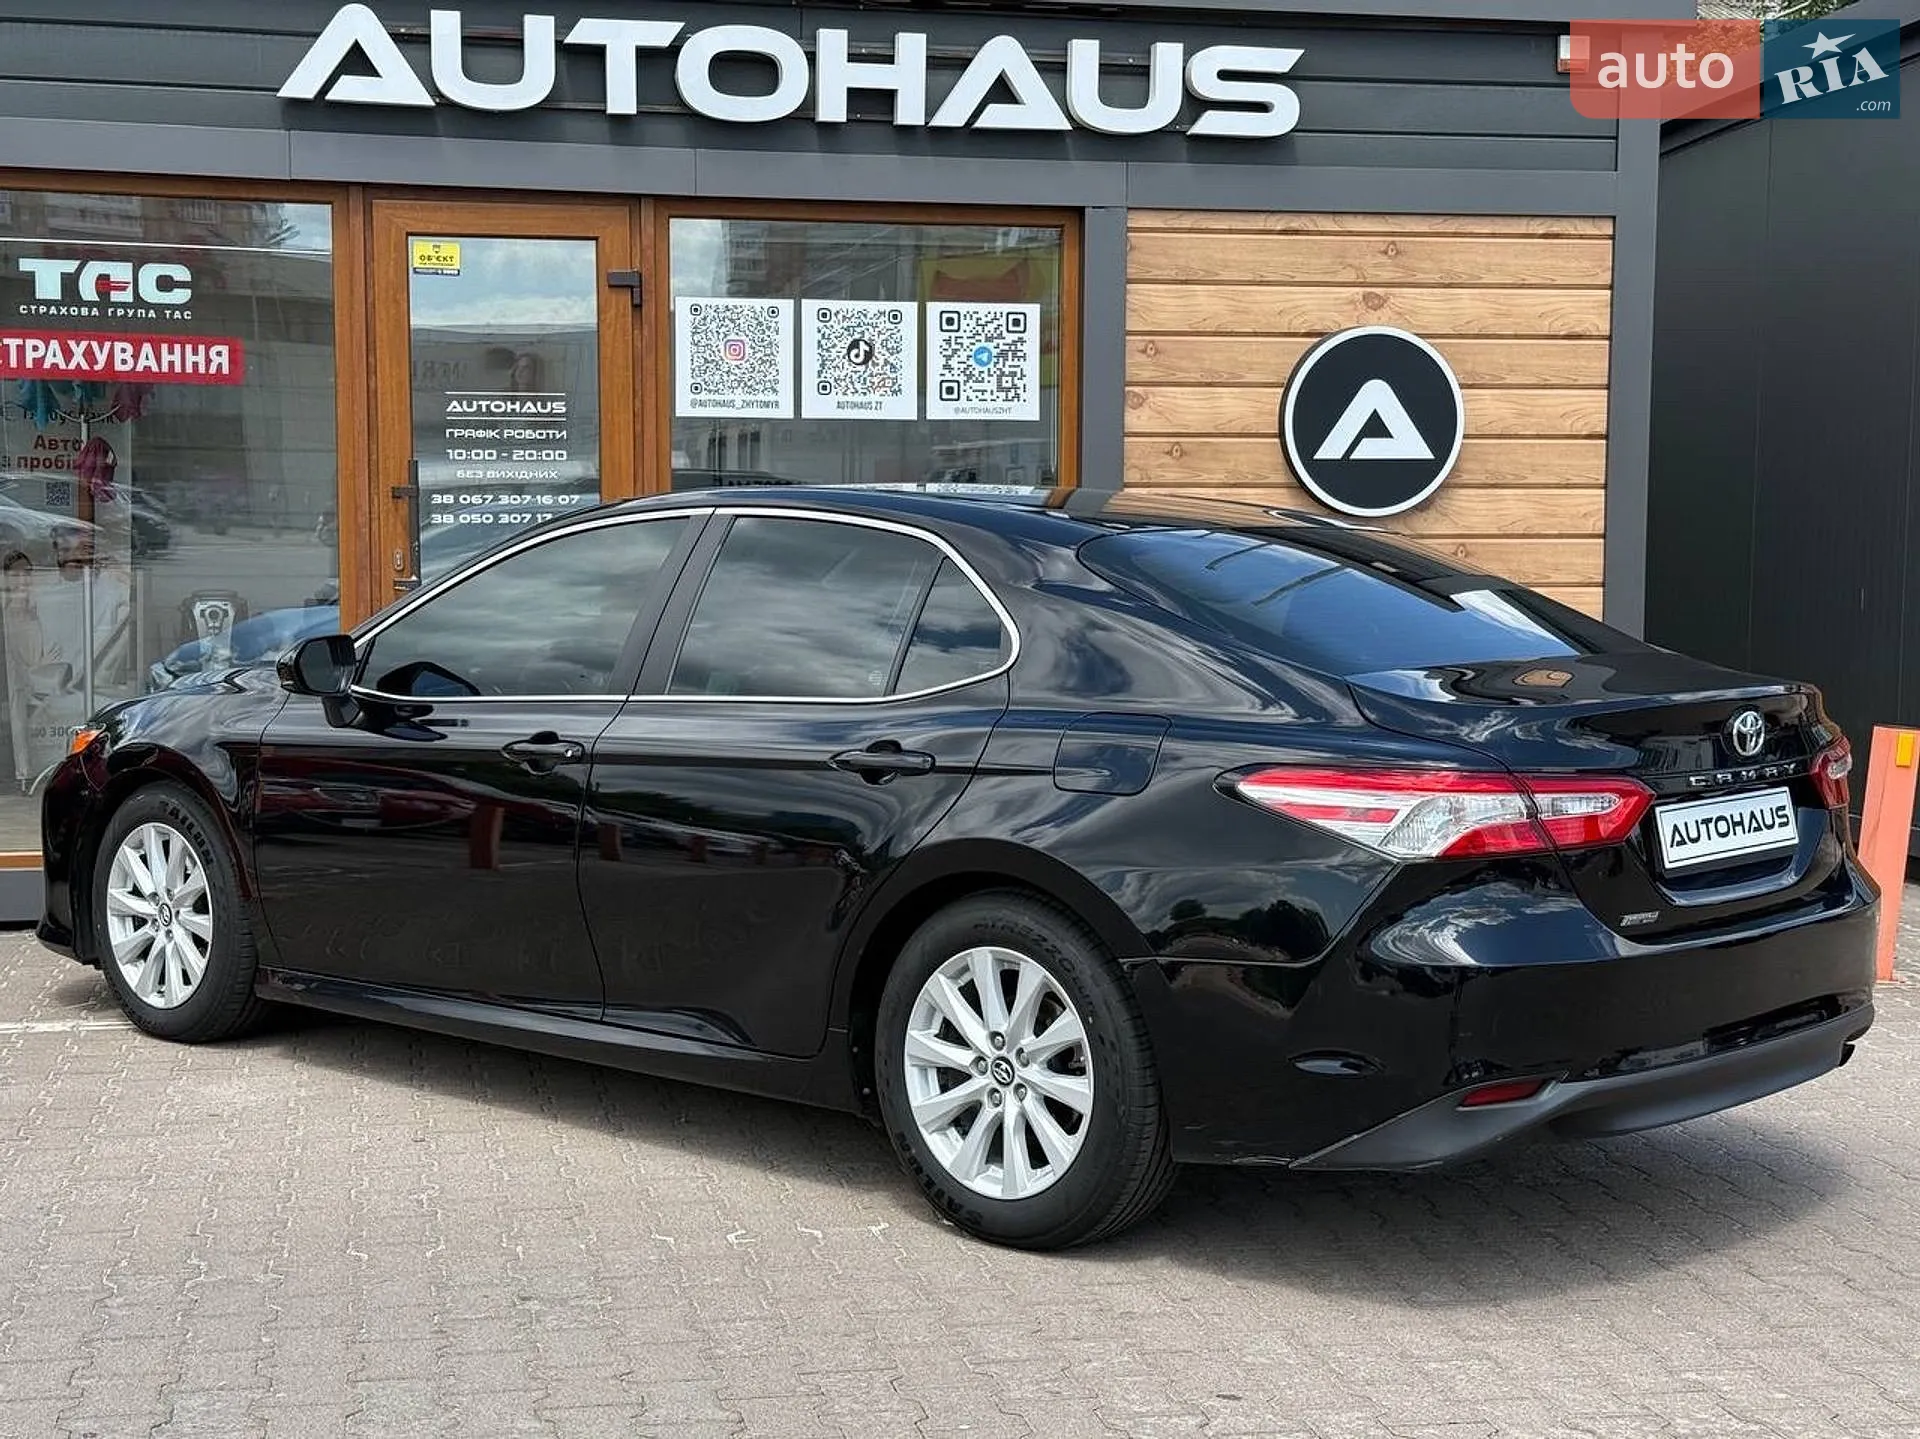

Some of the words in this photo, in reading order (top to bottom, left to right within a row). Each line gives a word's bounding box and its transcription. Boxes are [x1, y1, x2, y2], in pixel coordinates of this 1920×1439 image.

[277, 3, 1305, 138] AUTOHAUS
[19, 304, 100, 318] СТРАХОВА
[107, 307, 157, 319] ГРУПА
[164, 310, 193, 320] ТАС
[446, 400, 567, 414] AUTOHAUS
[836, 400, 873, 410] AUTOHAUS
[445, 428, 501, 440] ГРАФІК
[503, 429, 567, 441] РОБОТИ
[446, 449, 498, 461] 10:00
[512, 449, 567, 461] 20:00
[17, 453, 74, 473] пробі
[431, 494, 454, 505] 38
[459, 494, 494, 505] 067
[498, 494, 535, 505] 307
[536, 494, 554, 505] 16
[557, 494, 580, 505] 07
[431, 513, 454, 524] 38
[459, 513, 494, 524] 050
[498, 513, 533, 524] 307
[1689, 763, 1797, 786] CAMRY
[1669, 805, 1790, 848] AUTOHAUS
